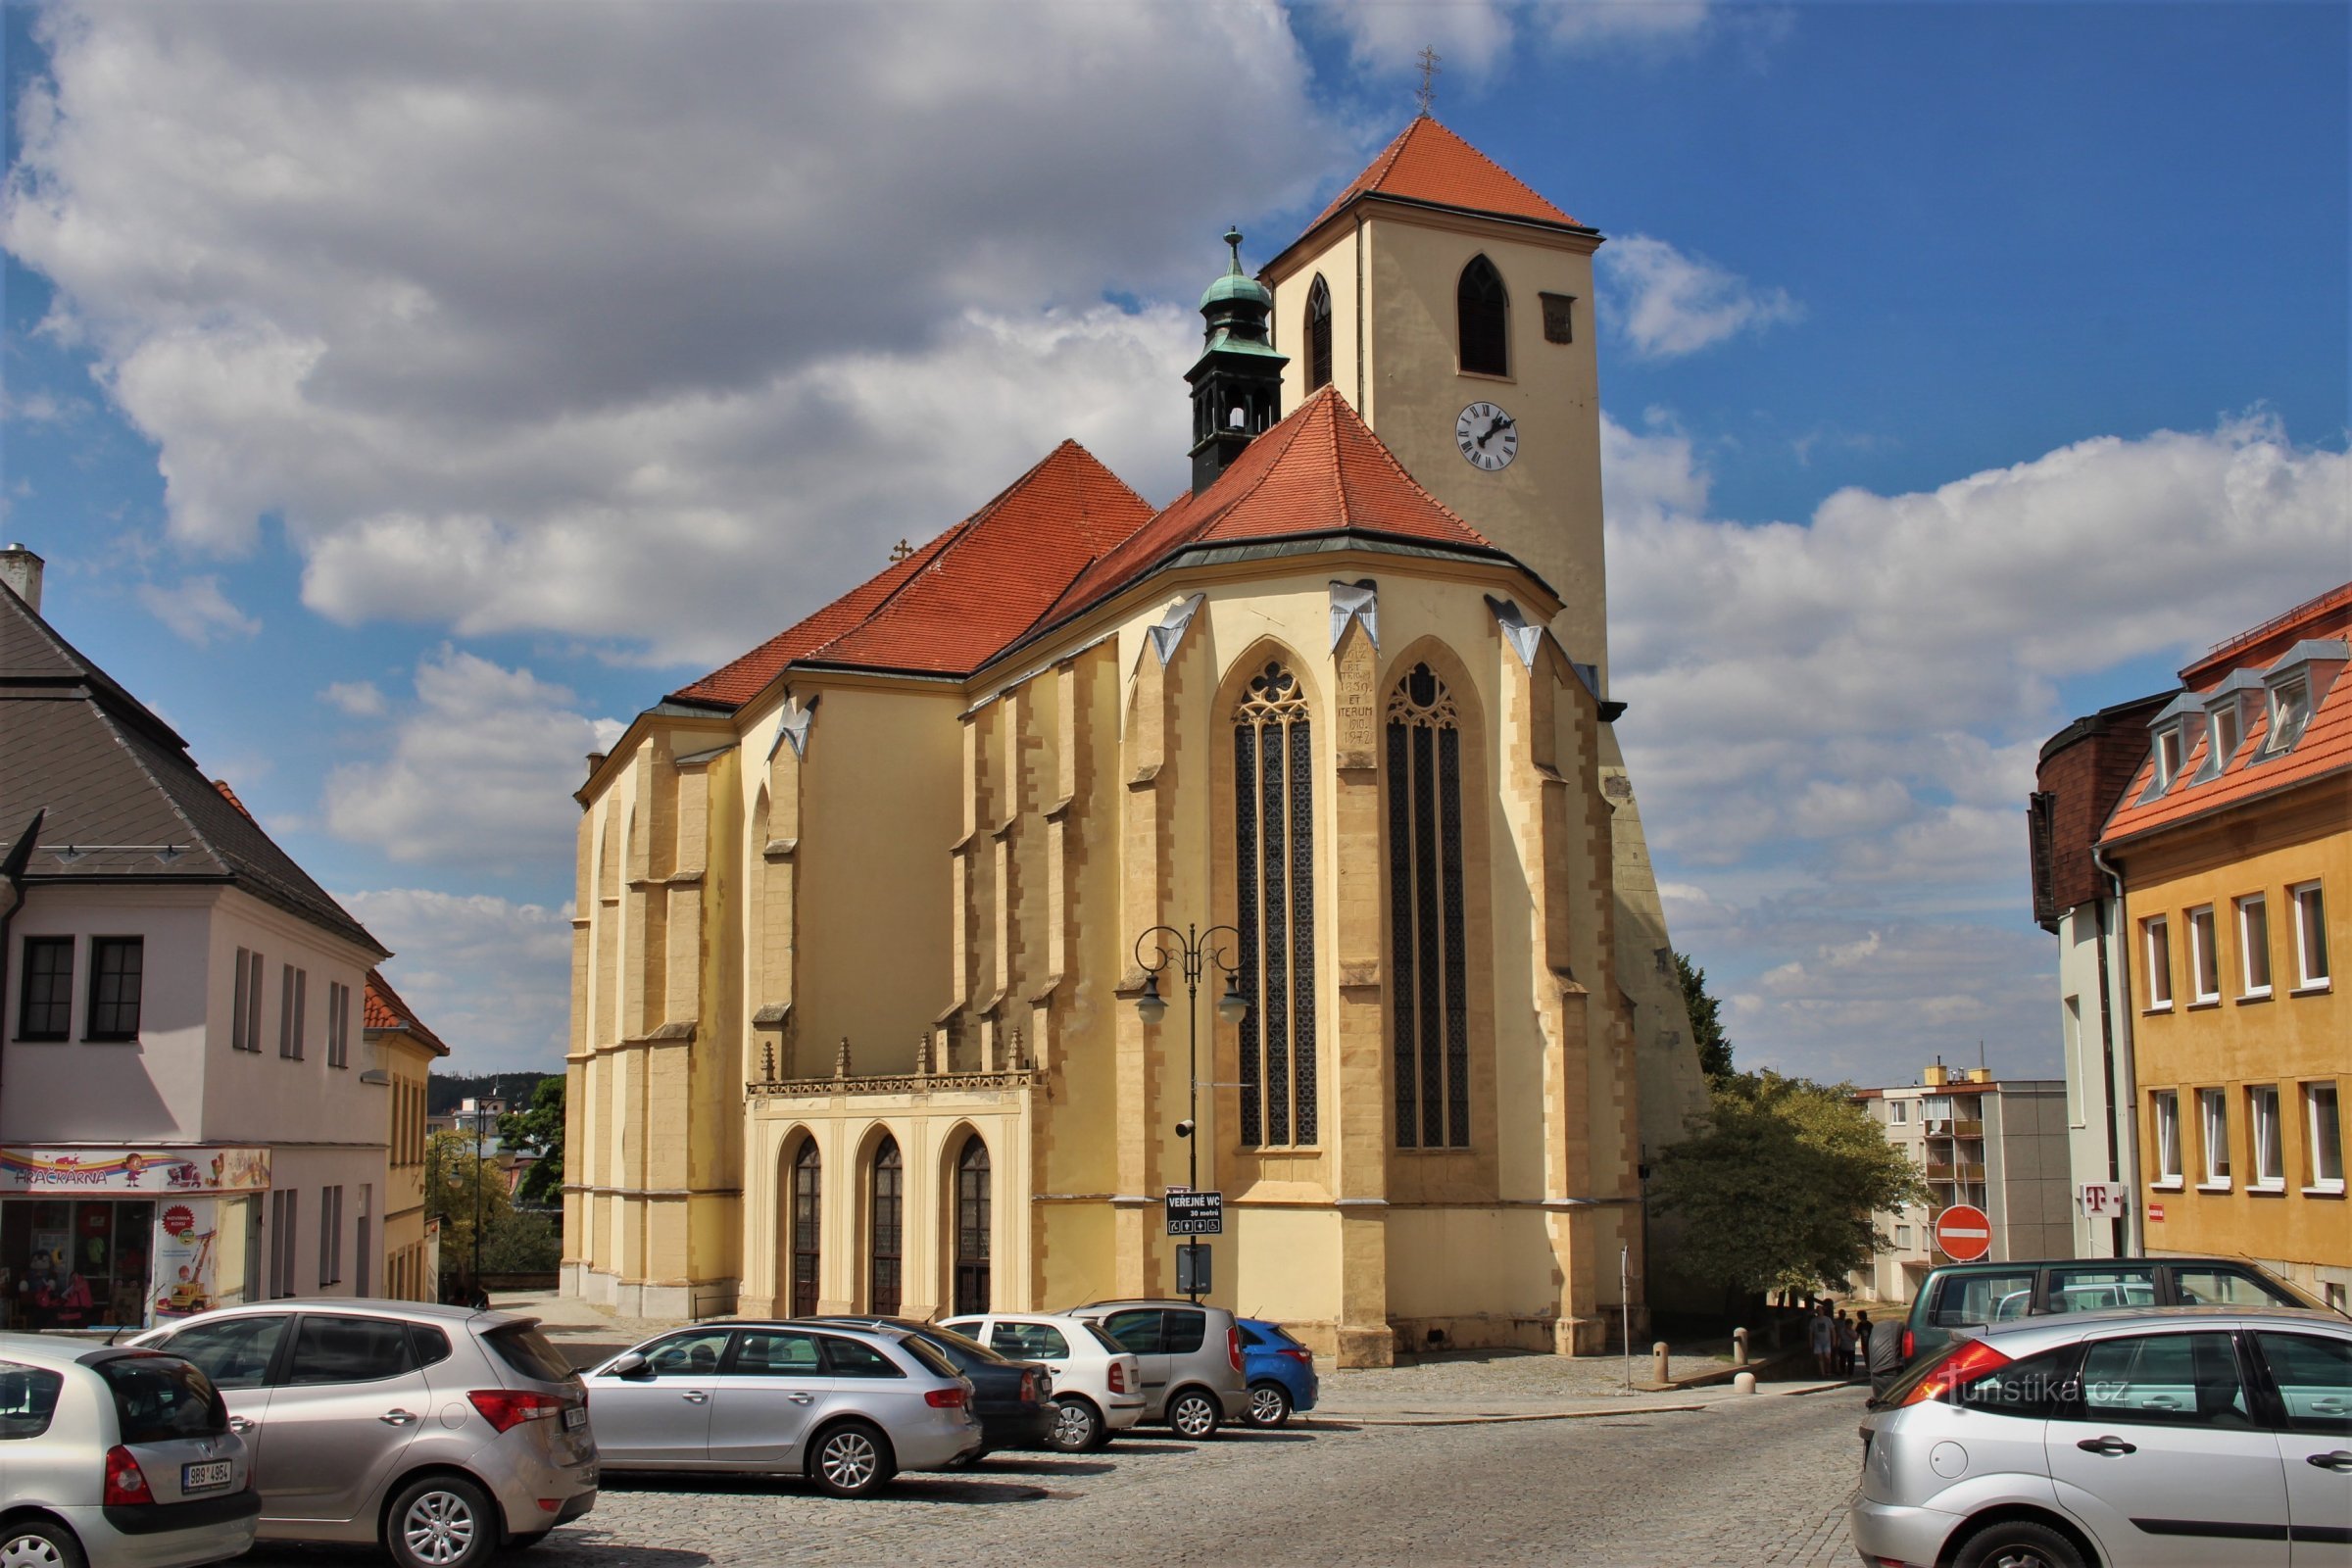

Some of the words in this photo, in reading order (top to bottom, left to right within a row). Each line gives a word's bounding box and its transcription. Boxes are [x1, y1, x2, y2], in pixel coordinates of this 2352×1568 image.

[1348, 696, 1360, 705] ET
[1338, 708, 1372, 717] ITERUM
[15, 1165, 108, 1185] HRAČKÁRNA
[1169, 1195, 1204, 1206] VEŘEJNÉ
[1206, 1196, 1220, 1206] WC
